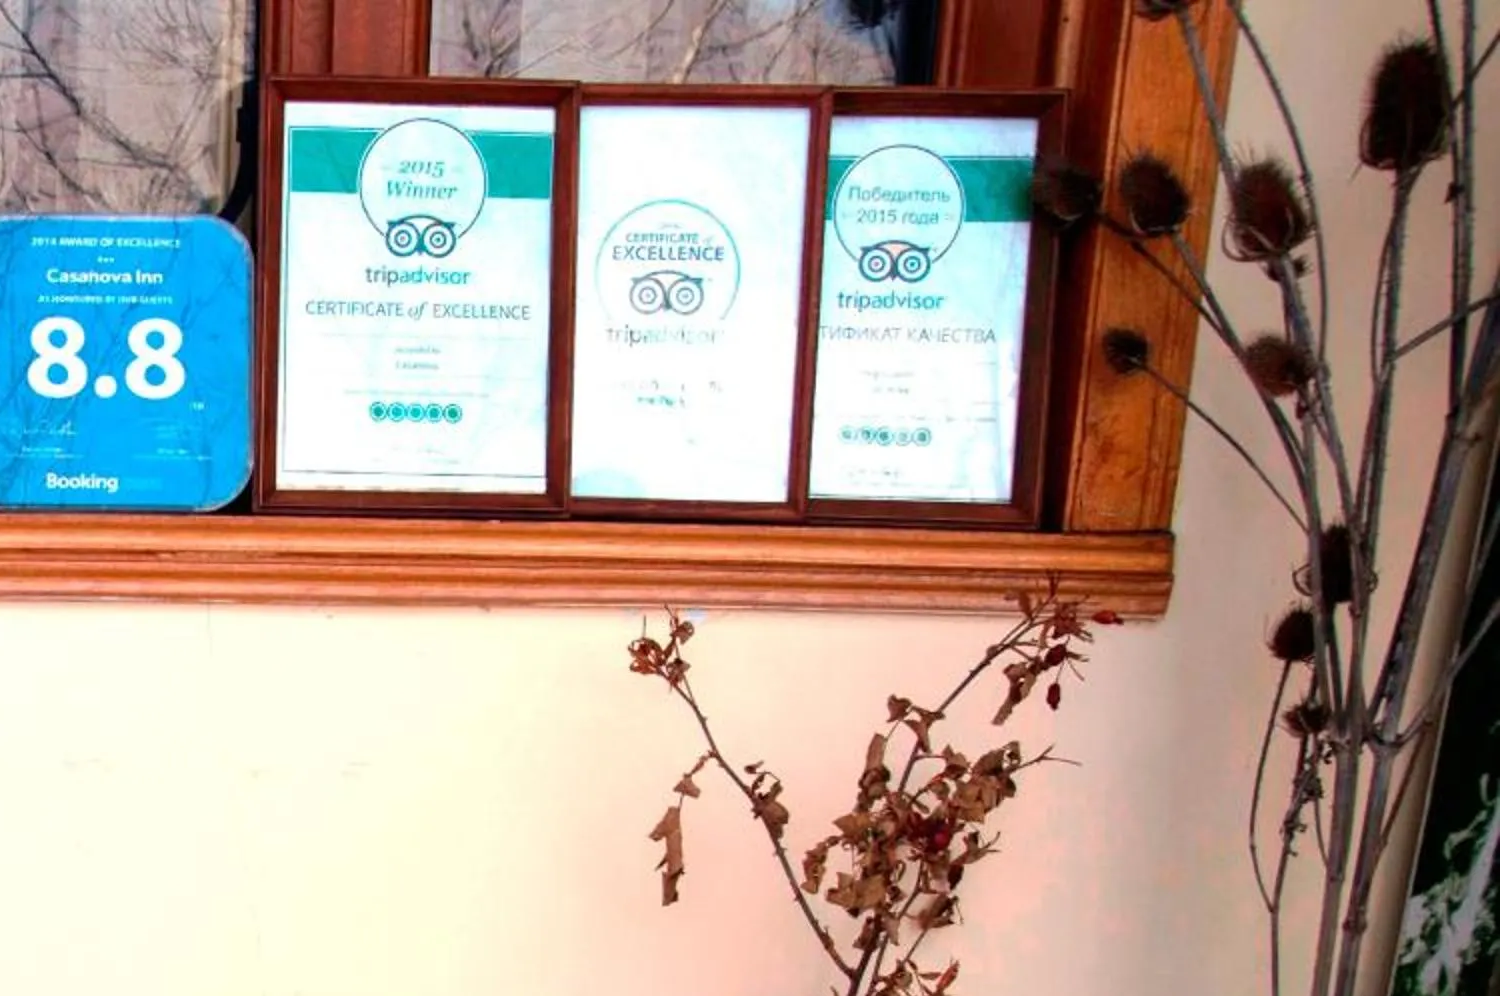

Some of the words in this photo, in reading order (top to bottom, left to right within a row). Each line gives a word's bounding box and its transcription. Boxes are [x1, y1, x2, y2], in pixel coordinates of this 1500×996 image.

[398, 160, 445, 178] 2015
[385, 179, 460, 200] Winner
[847, 185, 951, 203] Победитель
[856, 208, 897, 224] 2015
[901, 211, 940, 226] года
[625, 232, 699, 244] CERTIFICATE
[612, 245, 725, 262] EXCELLENCE
[46, 268, 133, 285] Casanova
[135, 269, 164, 285] Inn
[364, 264, 472, 288] tripadvisor
[836, 289, 945, 313] tripadvisor
[305, 300, 403, 318] CERTIFICATE
[407, 301, 428, 321] of
[432, 303, 532, 321] EXCELLENCE
[907, 326, 997, 344] КАЧЕСТВА
[26, 315, 187, 400] 8.8
[46, 472, 120, 494] Booking
